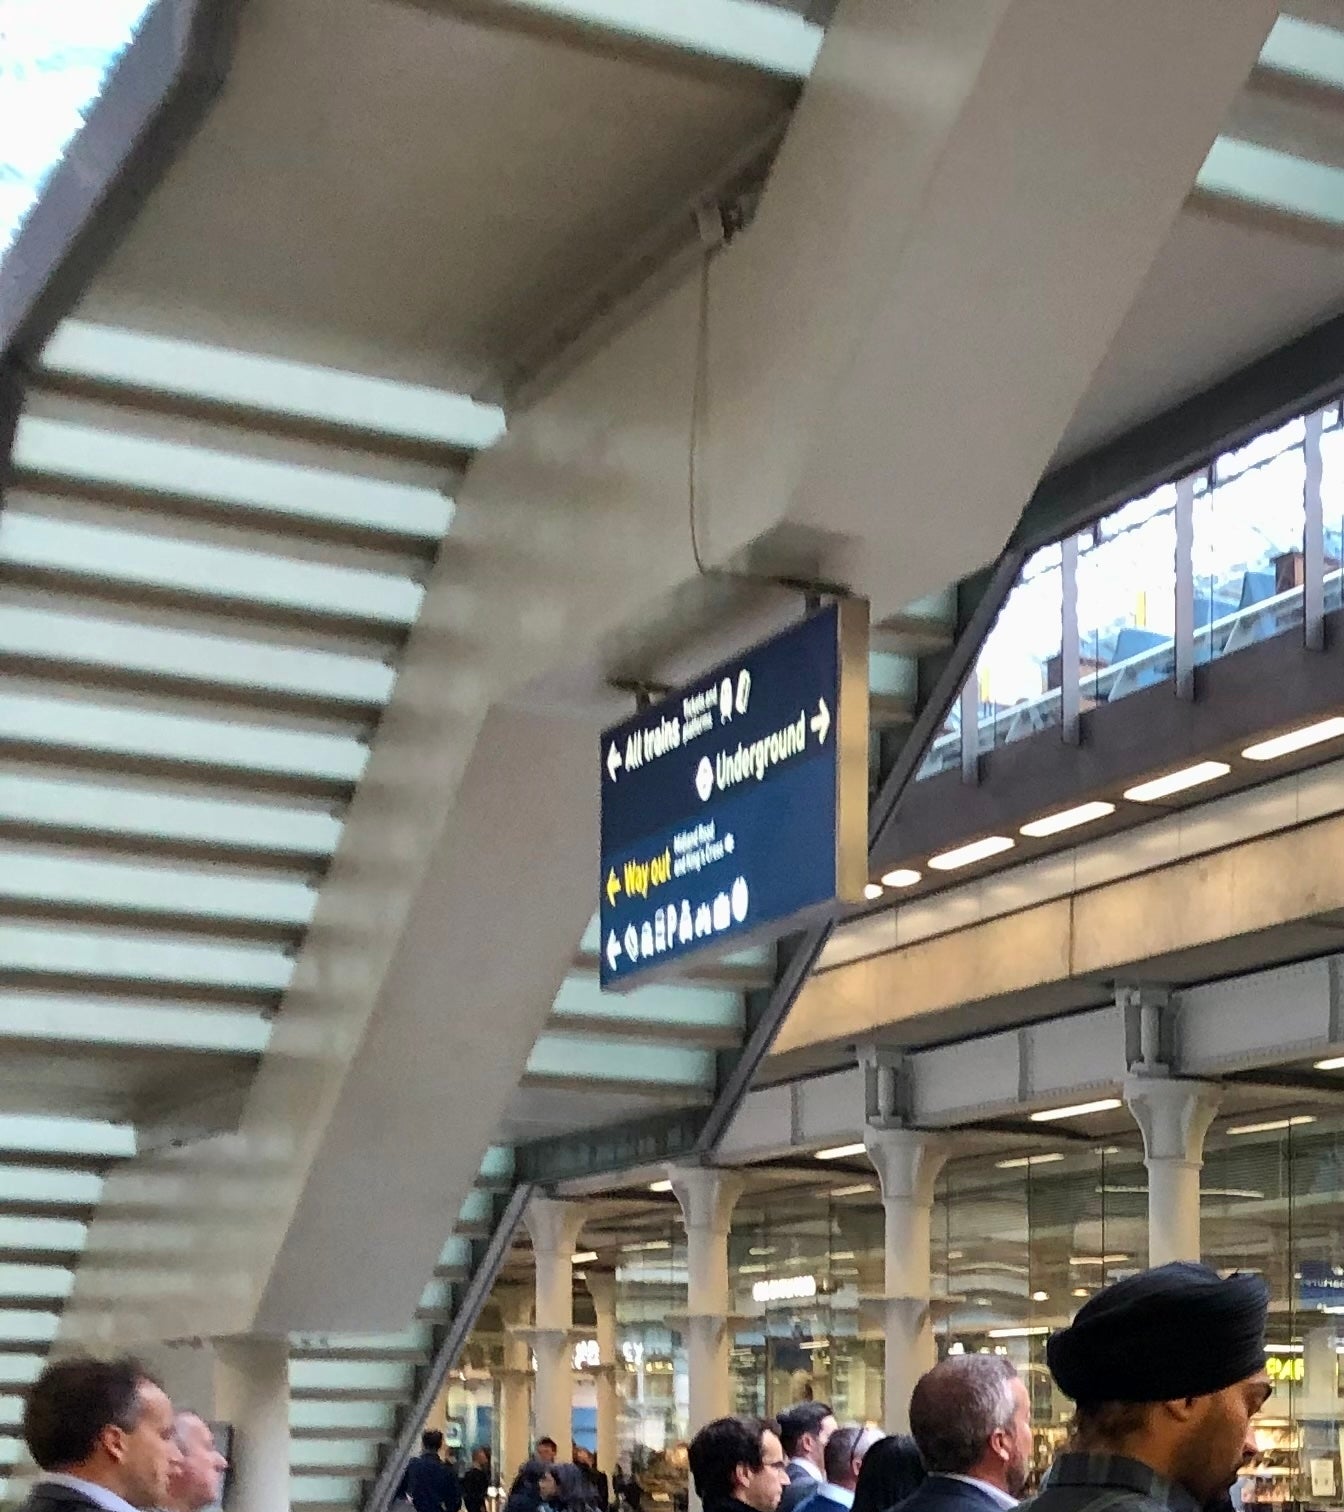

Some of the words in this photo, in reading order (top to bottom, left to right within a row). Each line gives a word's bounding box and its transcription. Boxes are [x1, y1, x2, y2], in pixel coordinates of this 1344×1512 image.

[625, 734, 643, 772] All
[644, 716, 680, 762] trains
[716, 709, 806, 791] Underground
[623, 858, 649, 899] Way
[650, 845, 671, 886] out
